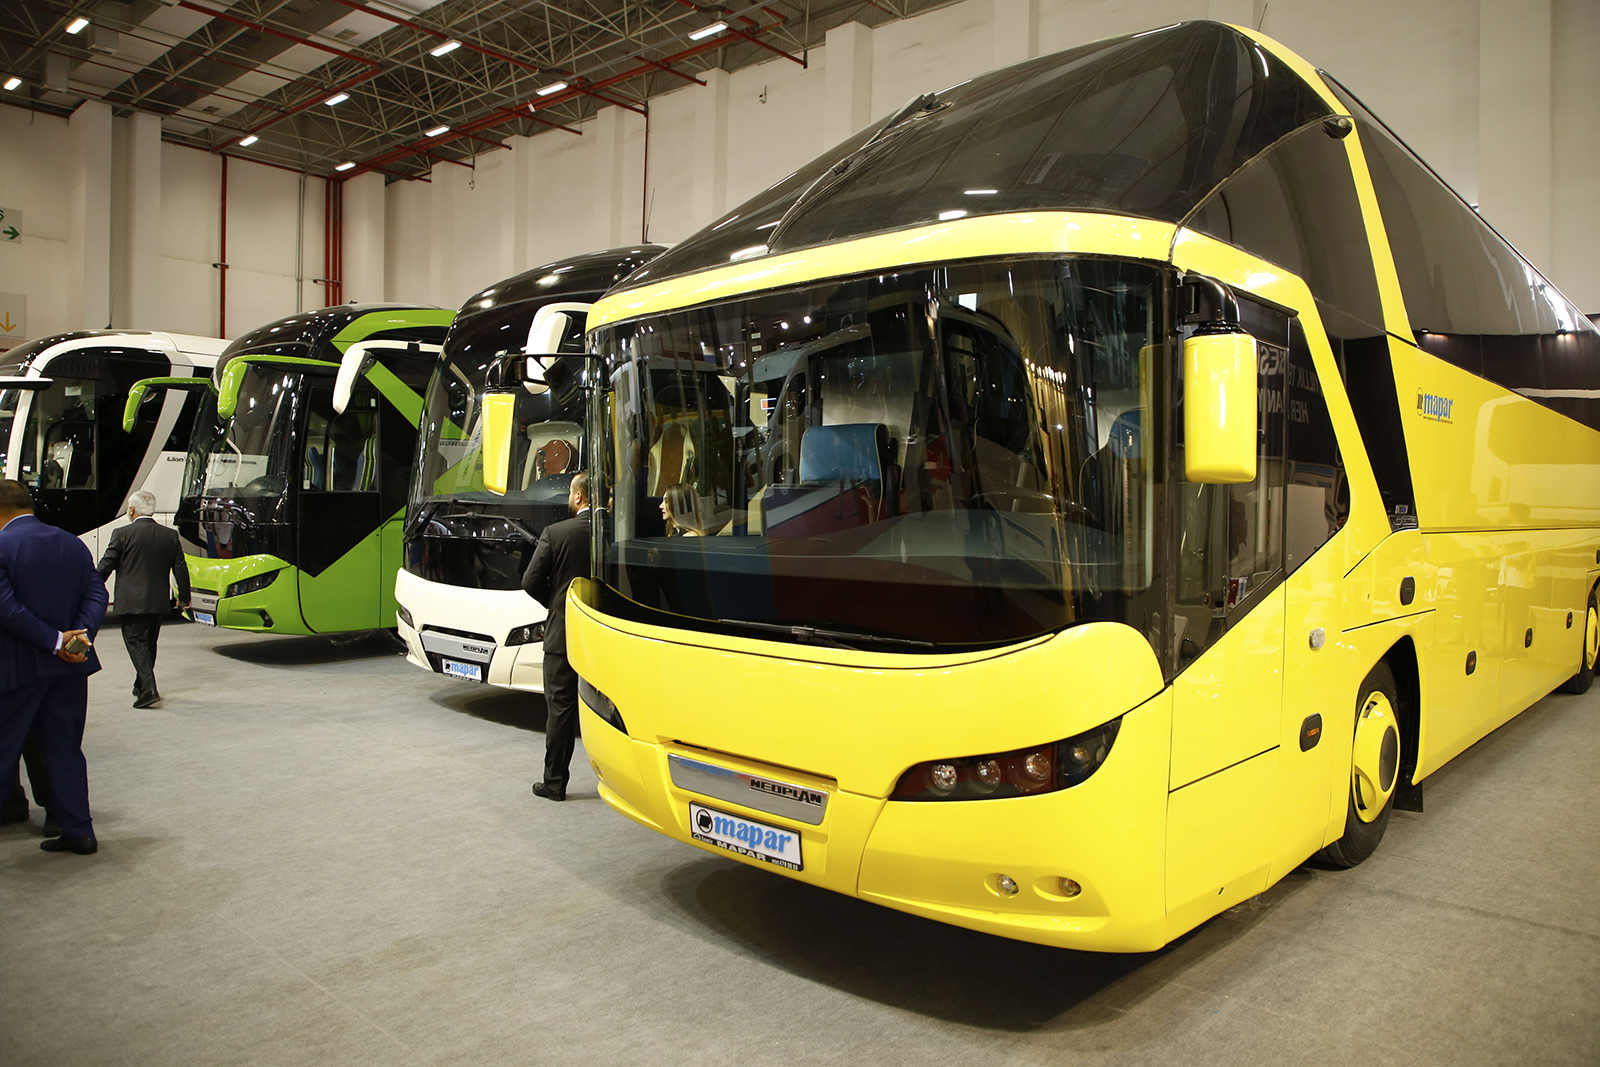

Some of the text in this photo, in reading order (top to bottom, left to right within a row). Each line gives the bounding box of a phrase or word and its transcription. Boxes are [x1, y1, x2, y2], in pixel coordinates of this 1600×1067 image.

[1423, 393, 1454, 422] mapar
[451, 662, 479, 676] mapar
[750, 778, 822, 804] NEOPLAN
[713, 815, 792, 853] mapar
[716, 840, 767, 862] MAPAR
